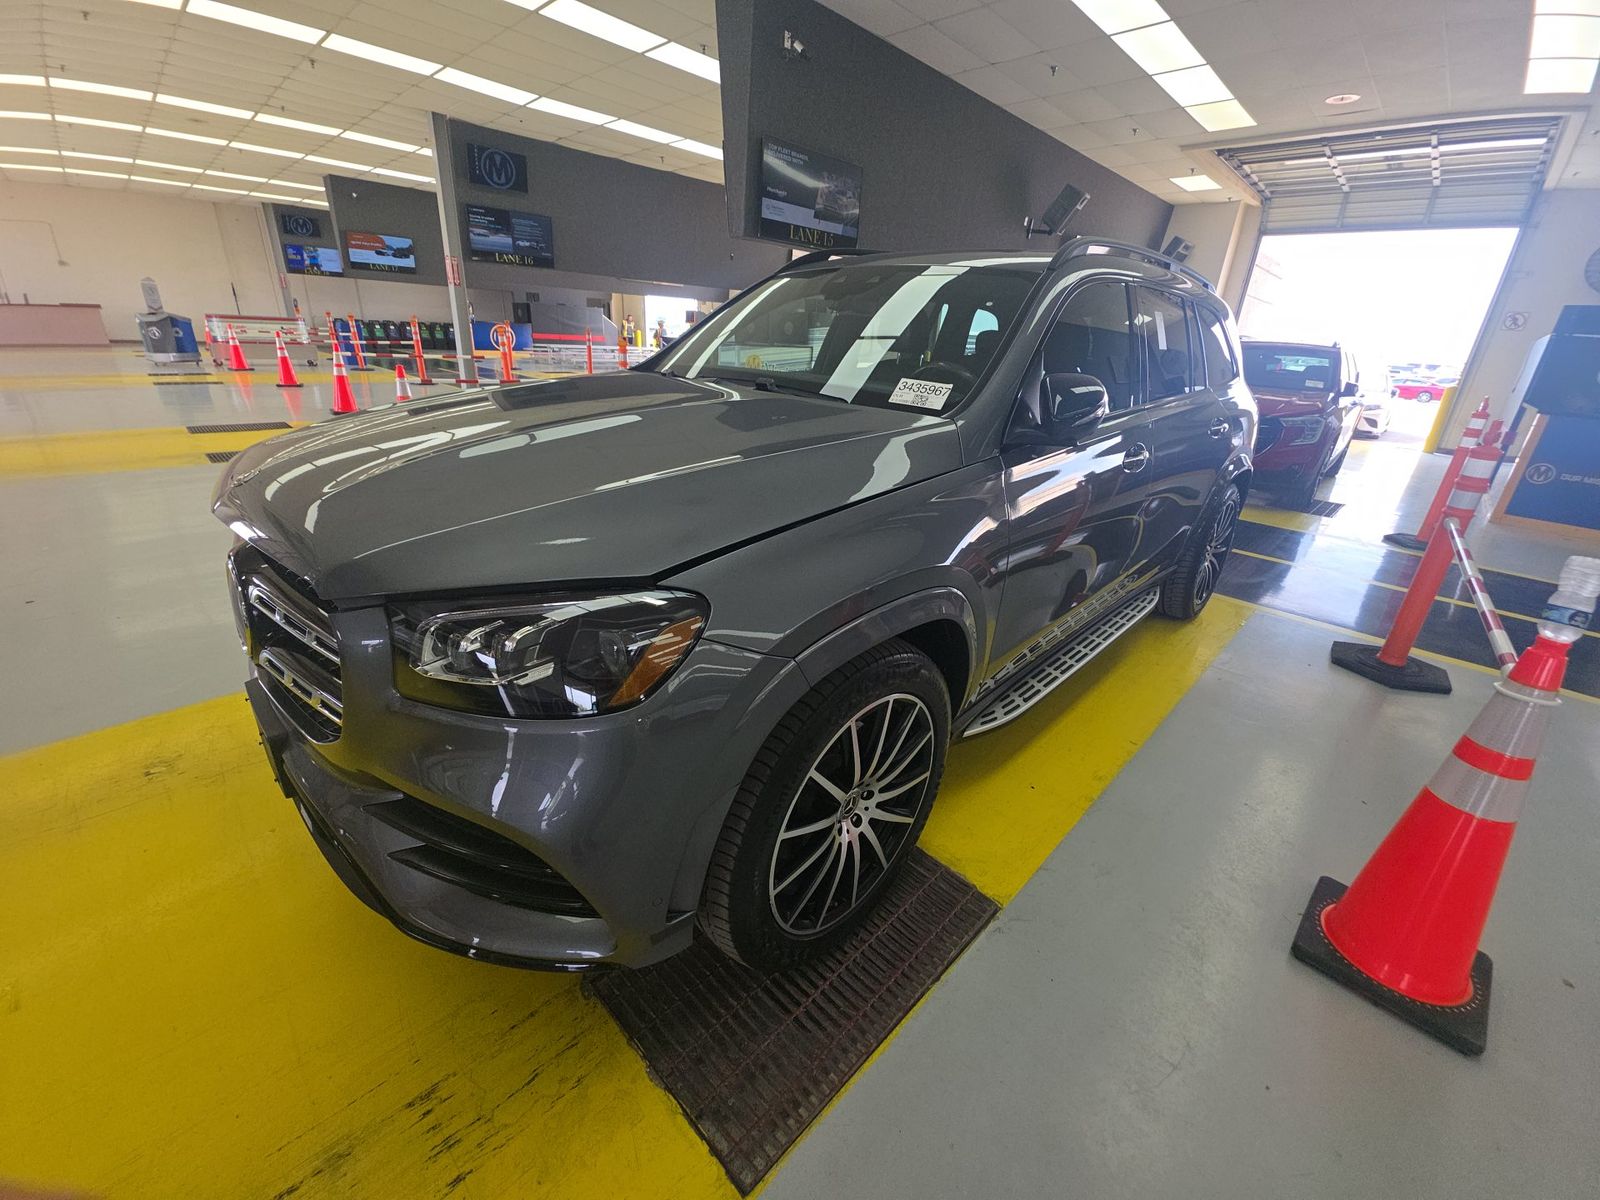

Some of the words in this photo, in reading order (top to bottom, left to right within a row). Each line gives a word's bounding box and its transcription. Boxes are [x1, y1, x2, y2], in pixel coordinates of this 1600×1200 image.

[790, 225, 821, 245] LANE
[823, 232, 834, 247] 15
[495, 252, 523, 265] LANE
[524, 256, 534, 265] 16
[369, 263, 389, 272] LANE
[898, 381, 952, 397] 3435967
